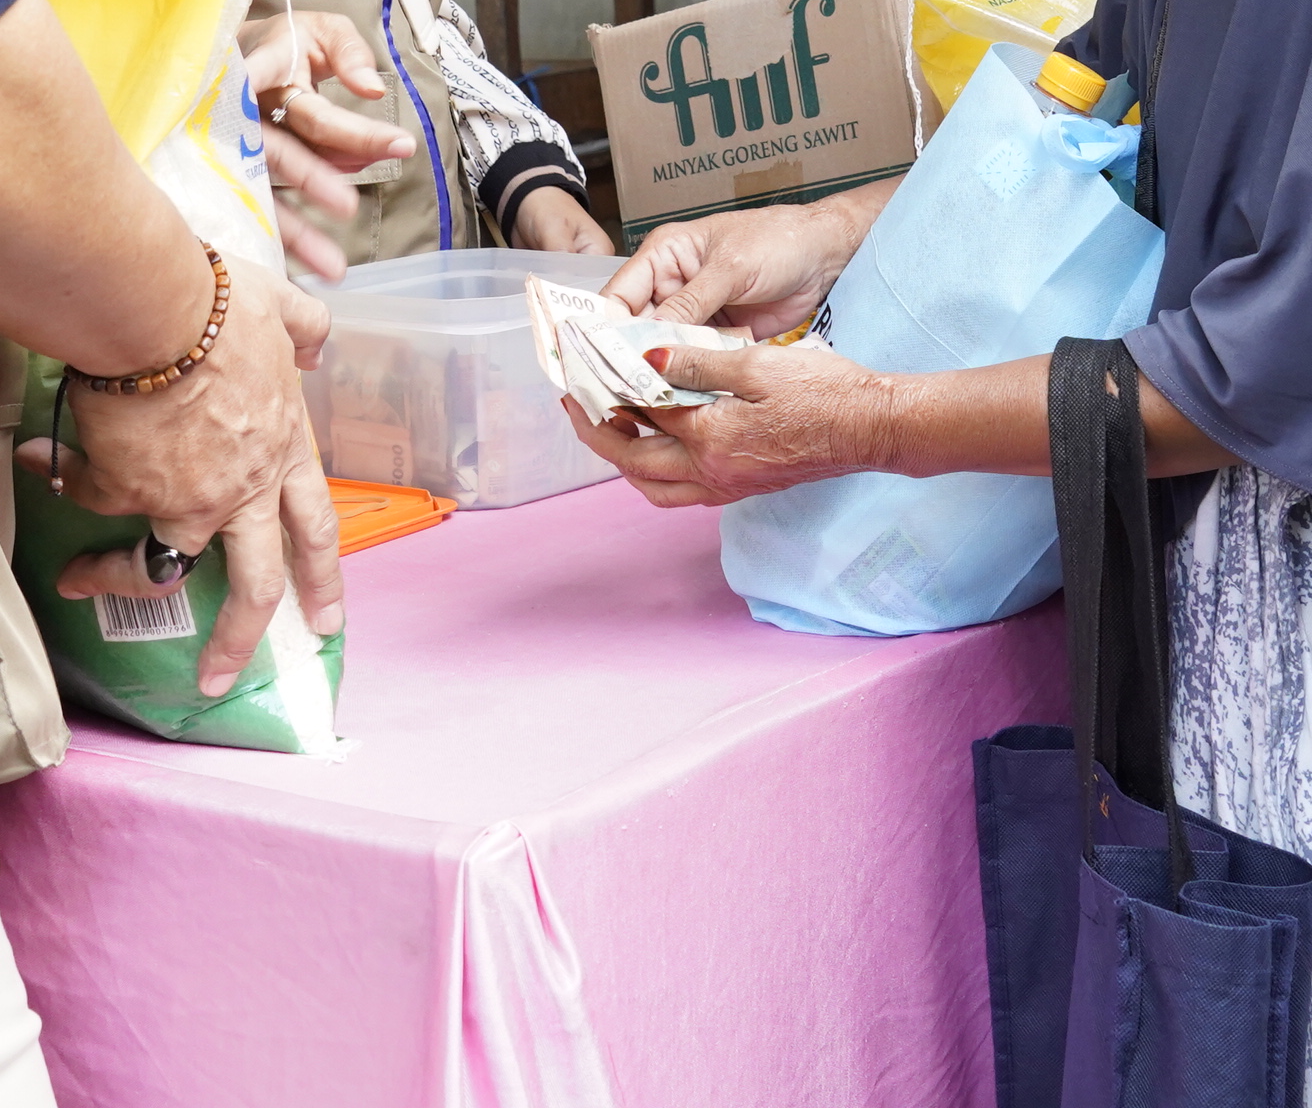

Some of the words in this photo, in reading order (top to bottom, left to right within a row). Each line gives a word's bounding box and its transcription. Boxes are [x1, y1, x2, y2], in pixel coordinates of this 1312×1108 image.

[653, 152, 721, 183] MINYAK
[722, 135, 799, 167] GORENG
[803, 121, 859, 150] SAWIT
[549, 289, 596, 313] 5000
